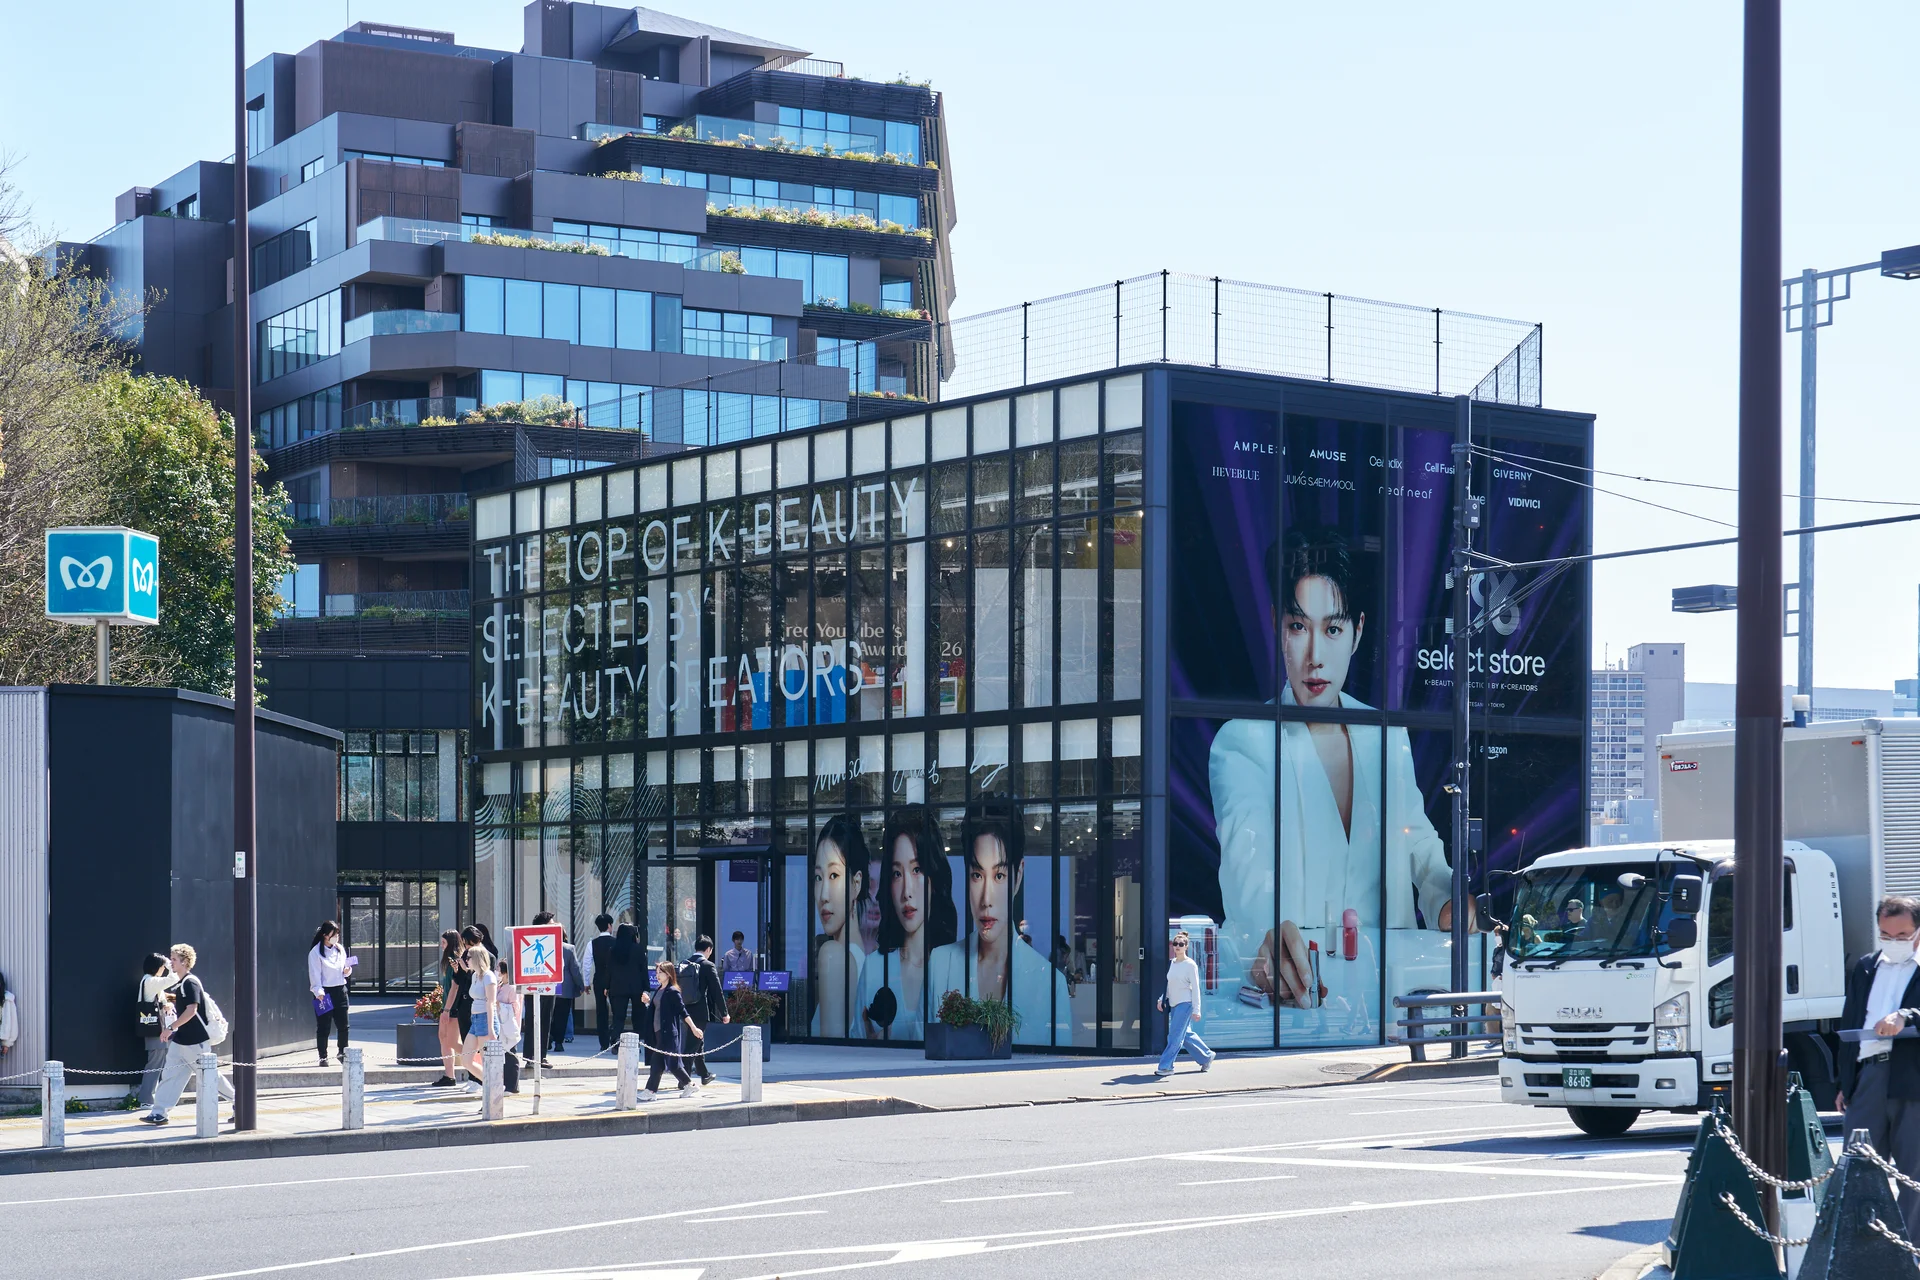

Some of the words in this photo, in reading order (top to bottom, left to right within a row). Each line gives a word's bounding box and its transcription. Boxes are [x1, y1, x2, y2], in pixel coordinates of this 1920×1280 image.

[1309, 449, 1347, 462] AMUSE
[1212, 466, 1260, 481] HEVEBLUE
[1424, 462, 1439, 473] Cell
[1440, 463, 1456, 475] Fusi
[1493, 468, 1533, 481] GIVERNY
[1407, 488, 1433, 500] neaf
[1508, 496, 1541, 510] VIDIVICI
[483, 541, 541, 594] THE
[558, 527, 628, 584] TOP
[642, 515, 691, 572] OF
[708, 477, 919, 562] K-BEAUTY
[482, 596, 654, 664] SELECTED
[669, 587, 710, 642] BY
[1489, 648, 1546, 677] store
[482, 664, 647, 728] K-BEAUTY
[657, 640, 863, 712] CREATORS
[1501, 683, 1538, 692] K-CREATORS
[1556, 1007, 1603, 1019] ISUZU
[1568, 1076, 1591, 1088] 86-05
